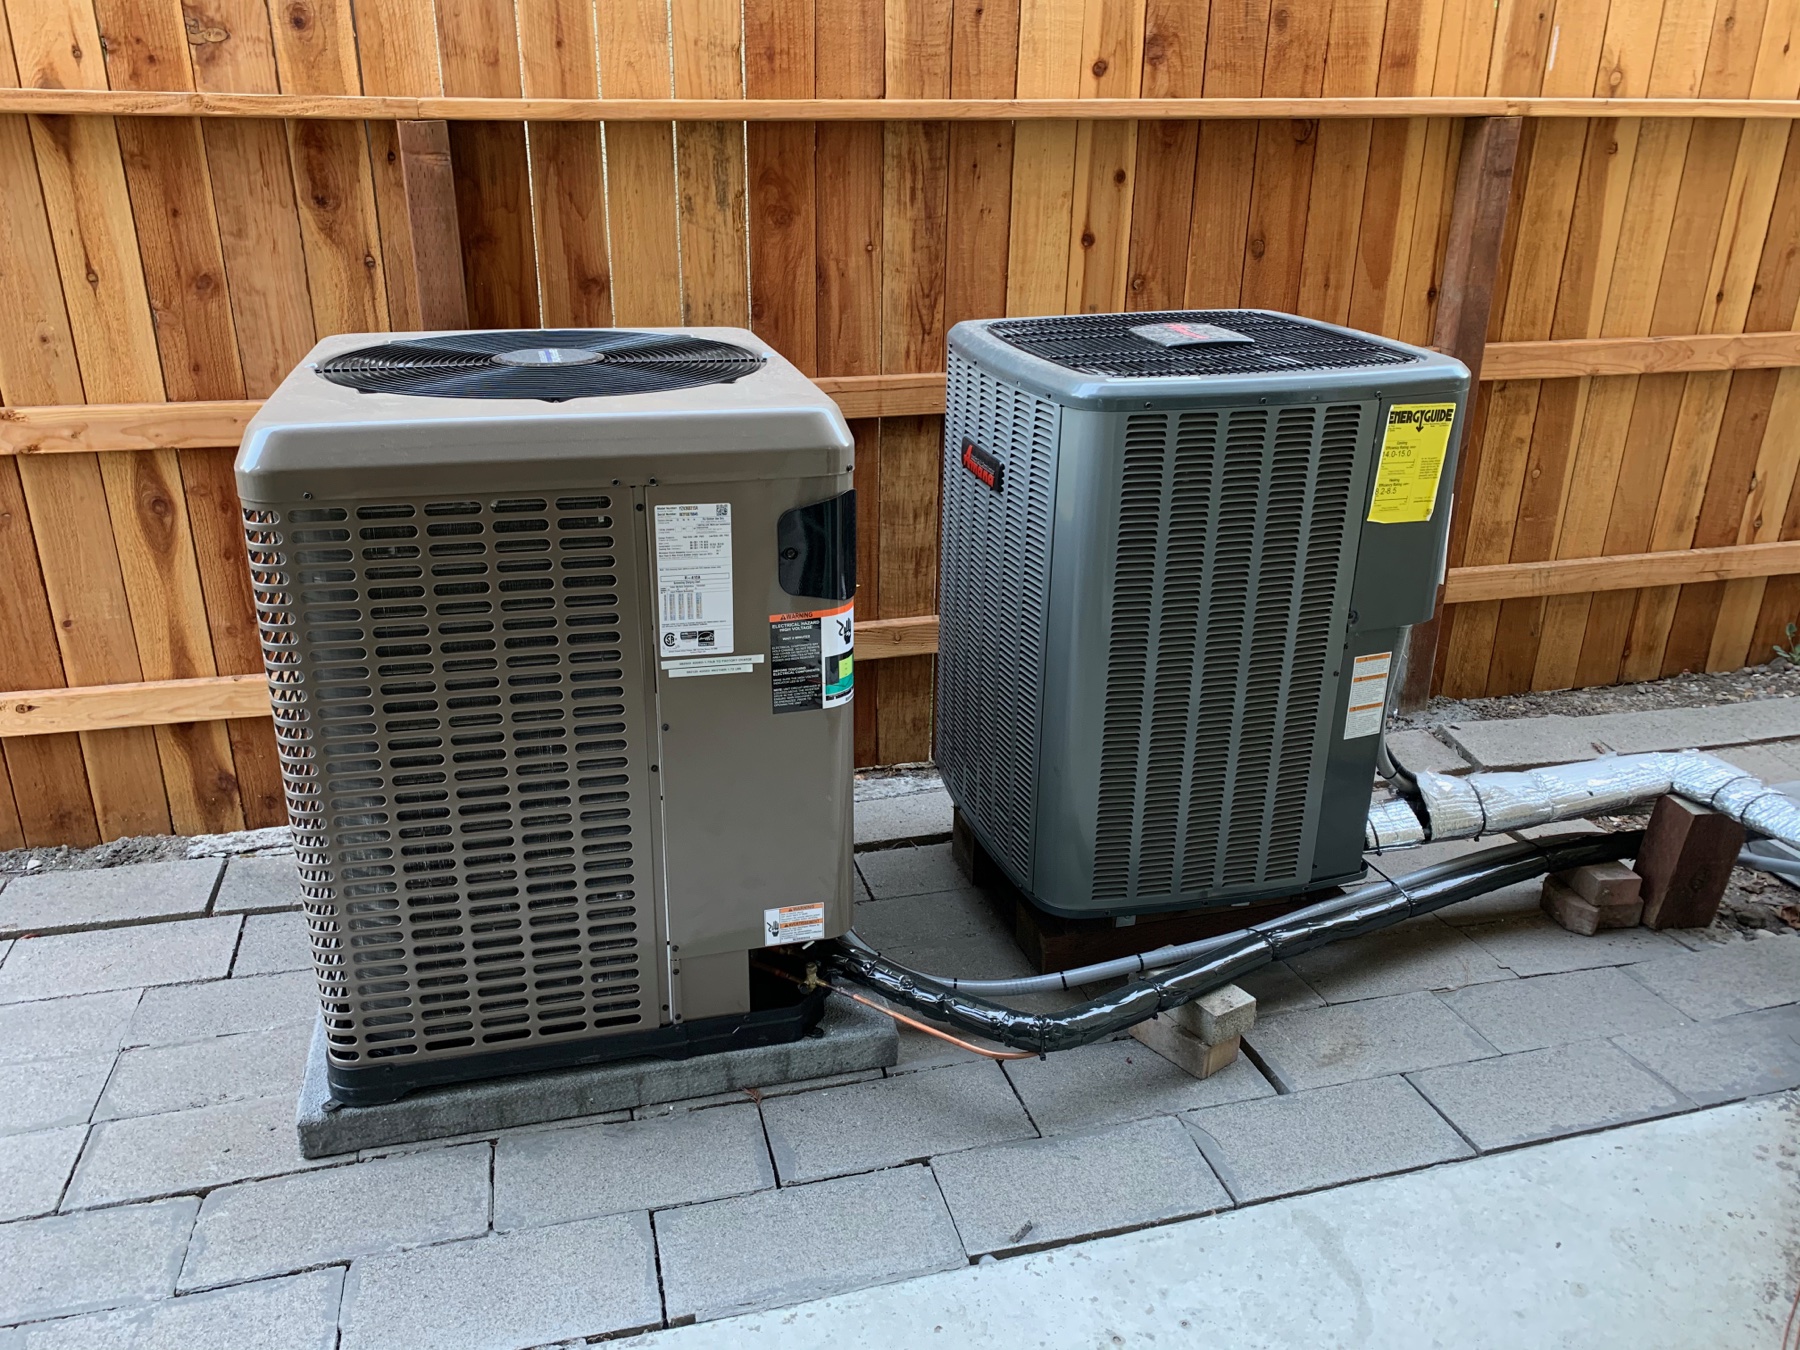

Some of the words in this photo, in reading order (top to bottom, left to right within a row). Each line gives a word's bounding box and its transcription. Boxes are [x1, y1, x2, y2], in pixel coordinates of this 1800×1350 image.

[1389, 409, 1454, 425] ENERGYGUIDE
[963, 444, 995, 487] Amana
[786, 612, 813, 620] WARNING
